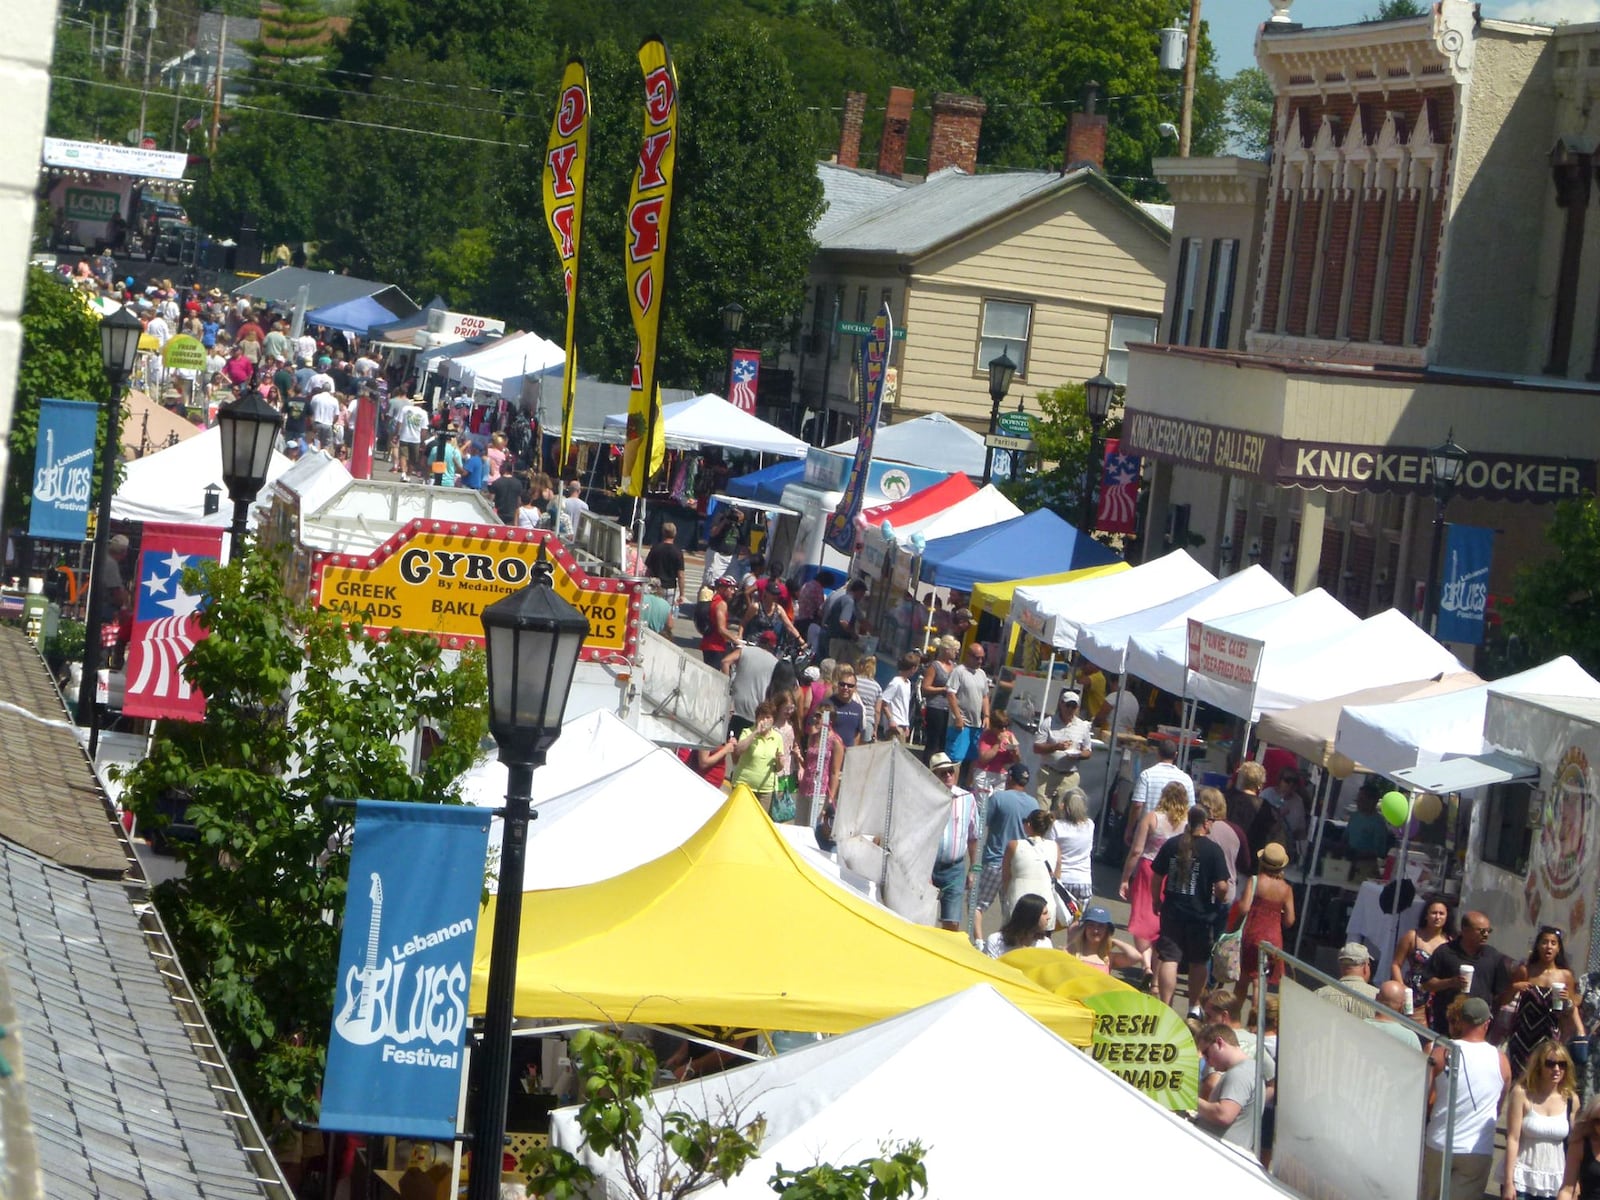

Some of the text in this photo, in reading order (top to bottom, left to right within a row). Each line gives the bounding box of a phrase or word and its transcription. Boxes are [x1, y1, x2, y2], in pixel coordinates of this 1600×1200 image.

[70, 194, 116, 213] LCNB
[454, 326, 478, 336] DRIN
[461, 317, 485, 329] COLD
[841, 323, 871, 332] MECHAN
[1001, 419, 1030, 427] DOWNTO
[994, 437, 1018, 448] Parking
[1129, 413, 1266, 474] KNICKERBOCKER GALLERY
[57, 448, 93, 466] Lebanon
[36, 465, 90, 502] BLUES
[54, 501, 88, 512] Festival
[336, 581, 397, 600] GREEK
[438, 579, 453, 590] By
[1442, 580, 1486, 612] BLUES
[432, 599, 488, 617] BAKL
[392, 918, 473, 962] Lebanon
[342, 958, 466, 1047] BLUES
[382, 1045, 457, 1069] Festival
[1091, 1043, 1178, 1064] UEEZED
